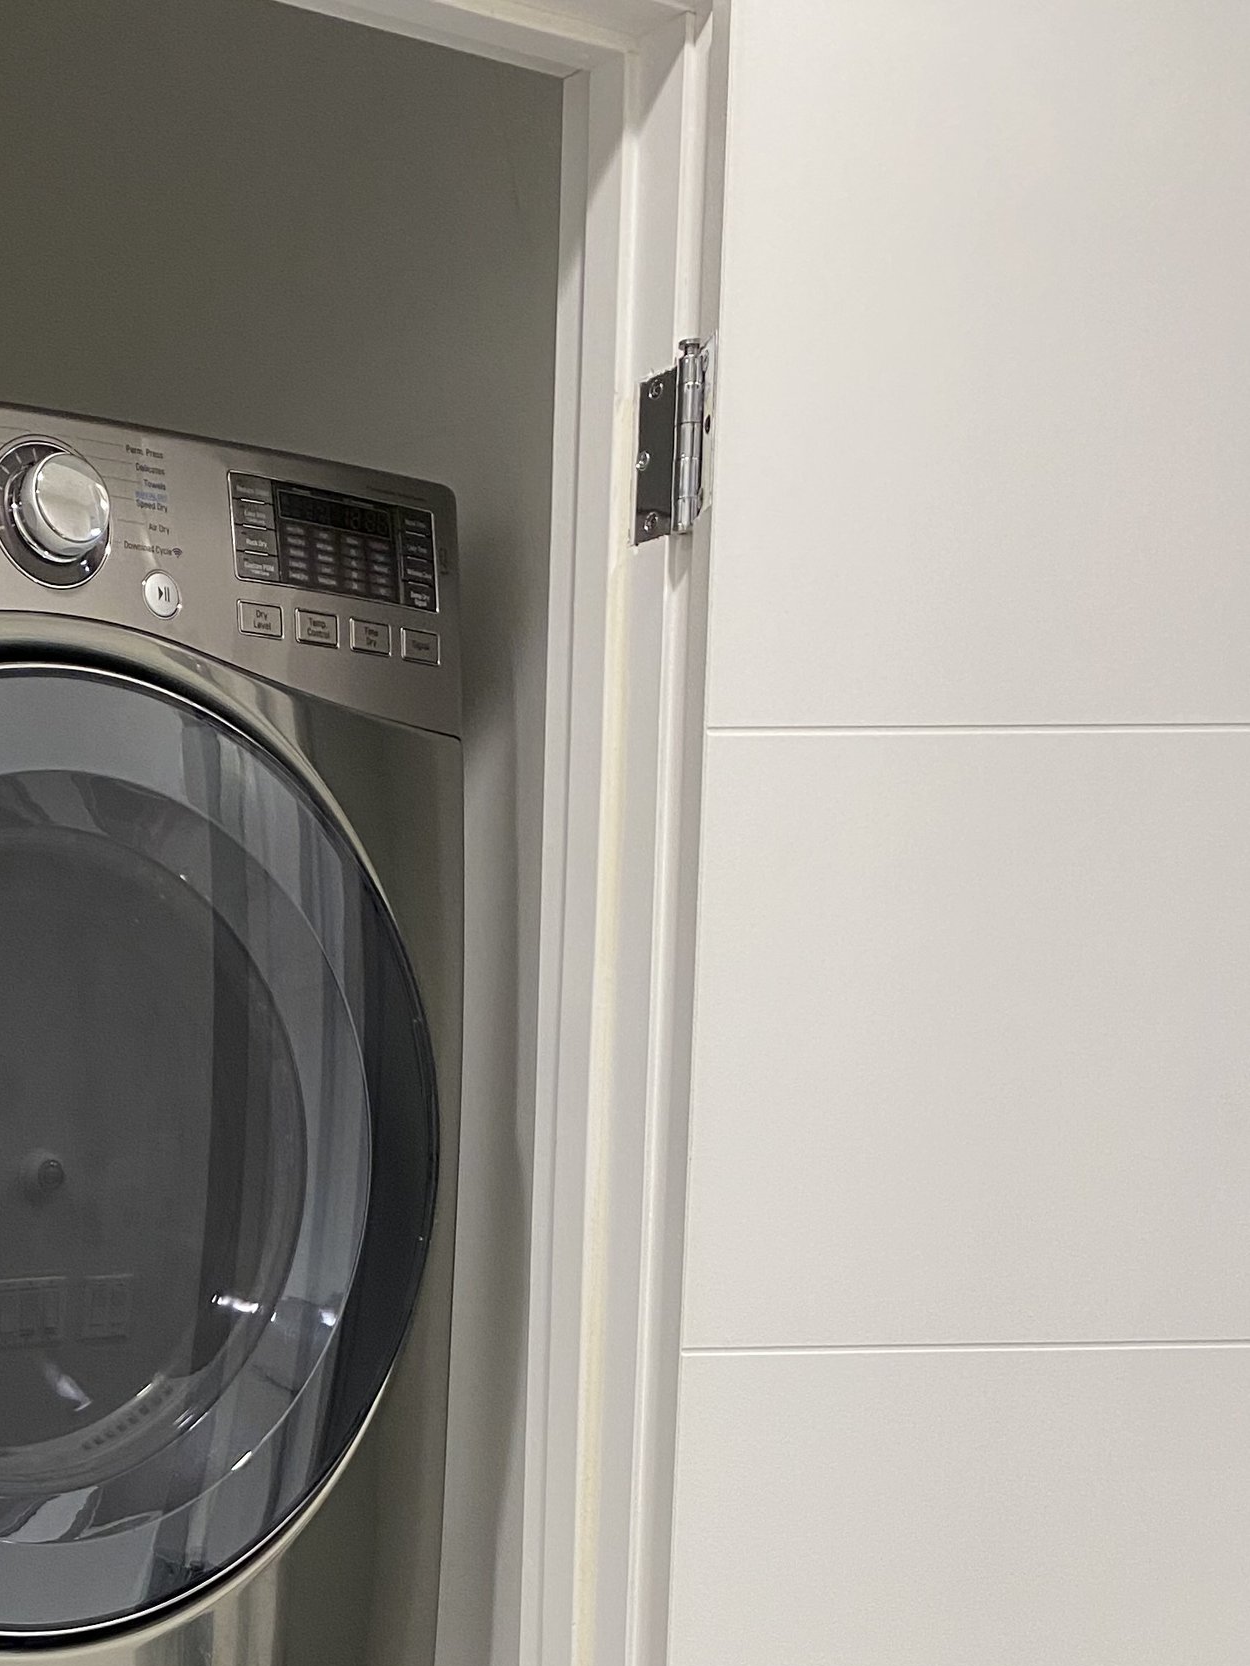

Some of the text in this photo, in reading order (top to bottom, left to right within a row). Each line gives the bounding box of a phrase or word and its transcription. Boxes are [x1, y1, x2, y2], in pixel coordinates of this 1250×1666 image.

[157, 502, 168, 513] Dry
[159, 524, 170, 535] Dry
[256, 609, 268, 620] Dry
[253, 620, 272, 631] Level
[307, 628, 330, 639] Control
